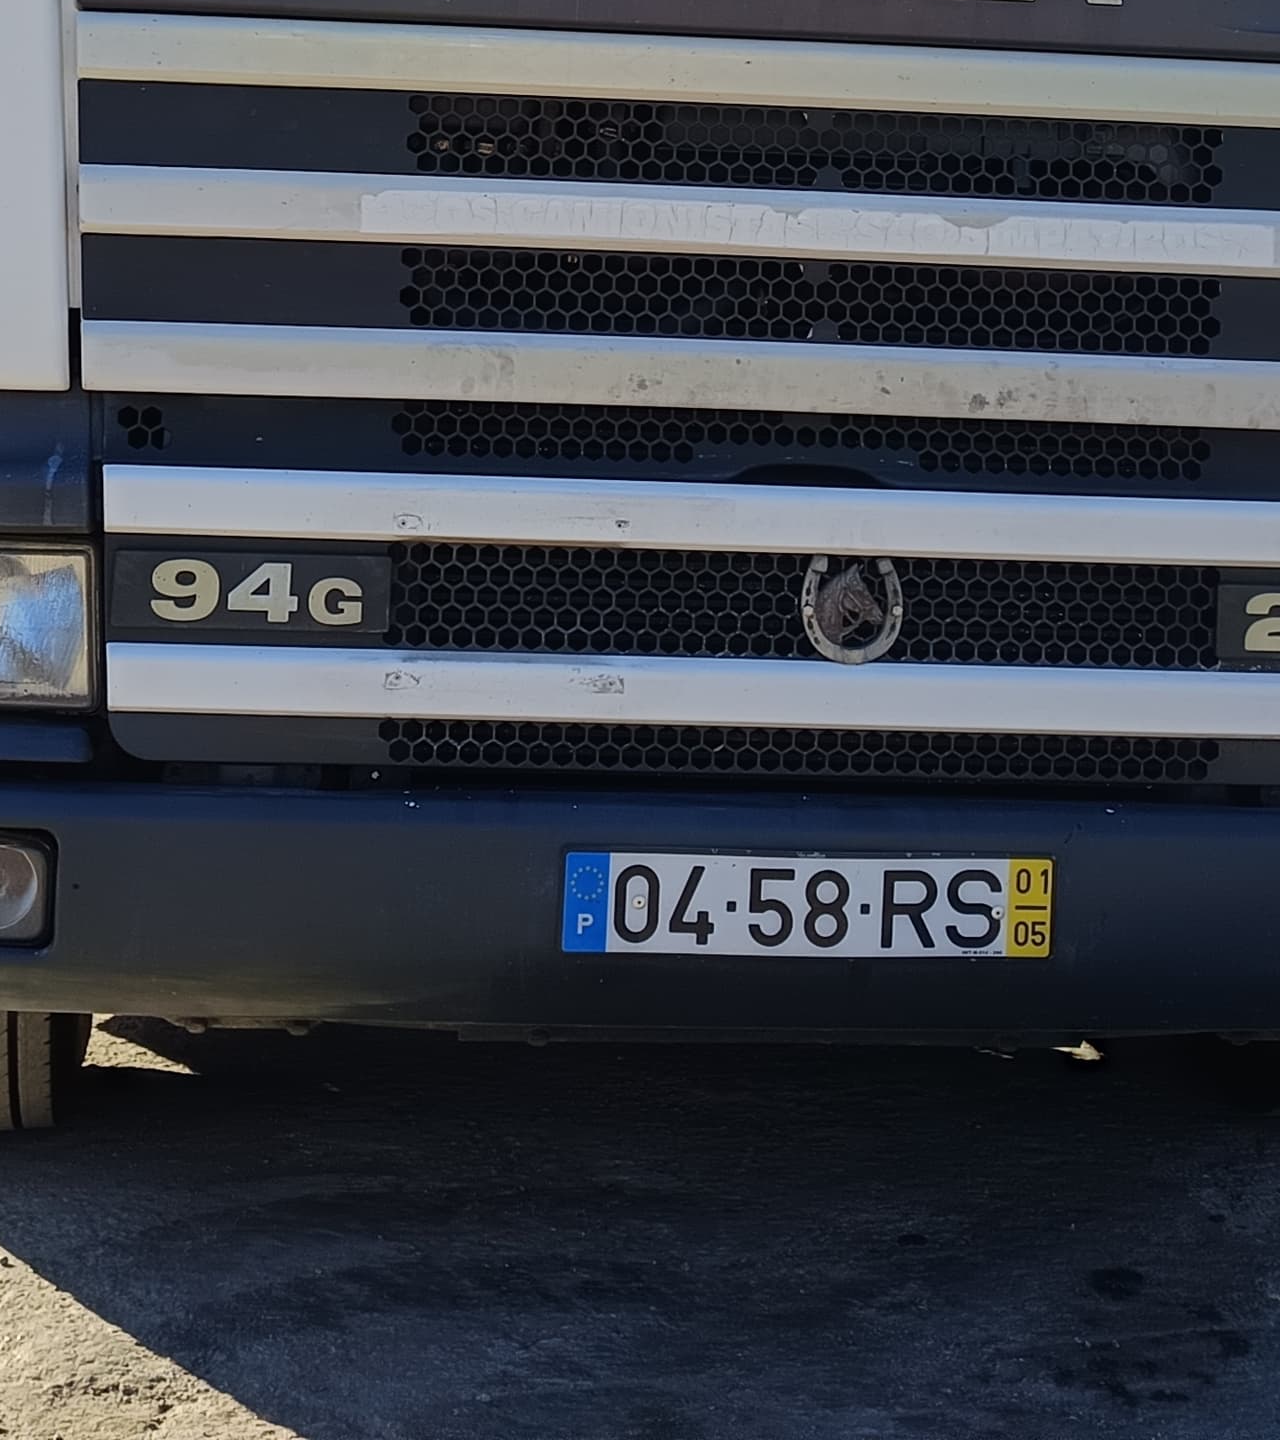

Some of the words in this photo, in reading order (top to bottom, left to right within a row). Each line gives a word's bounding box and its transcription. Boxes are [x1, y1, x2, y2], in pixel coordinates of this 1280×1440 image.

[150, 558, 363, 625] 94G
[1015, 868, 1049, 895] 01
[576, 913, 594, 935] P
[1013, 920, 1047, 947] 05
